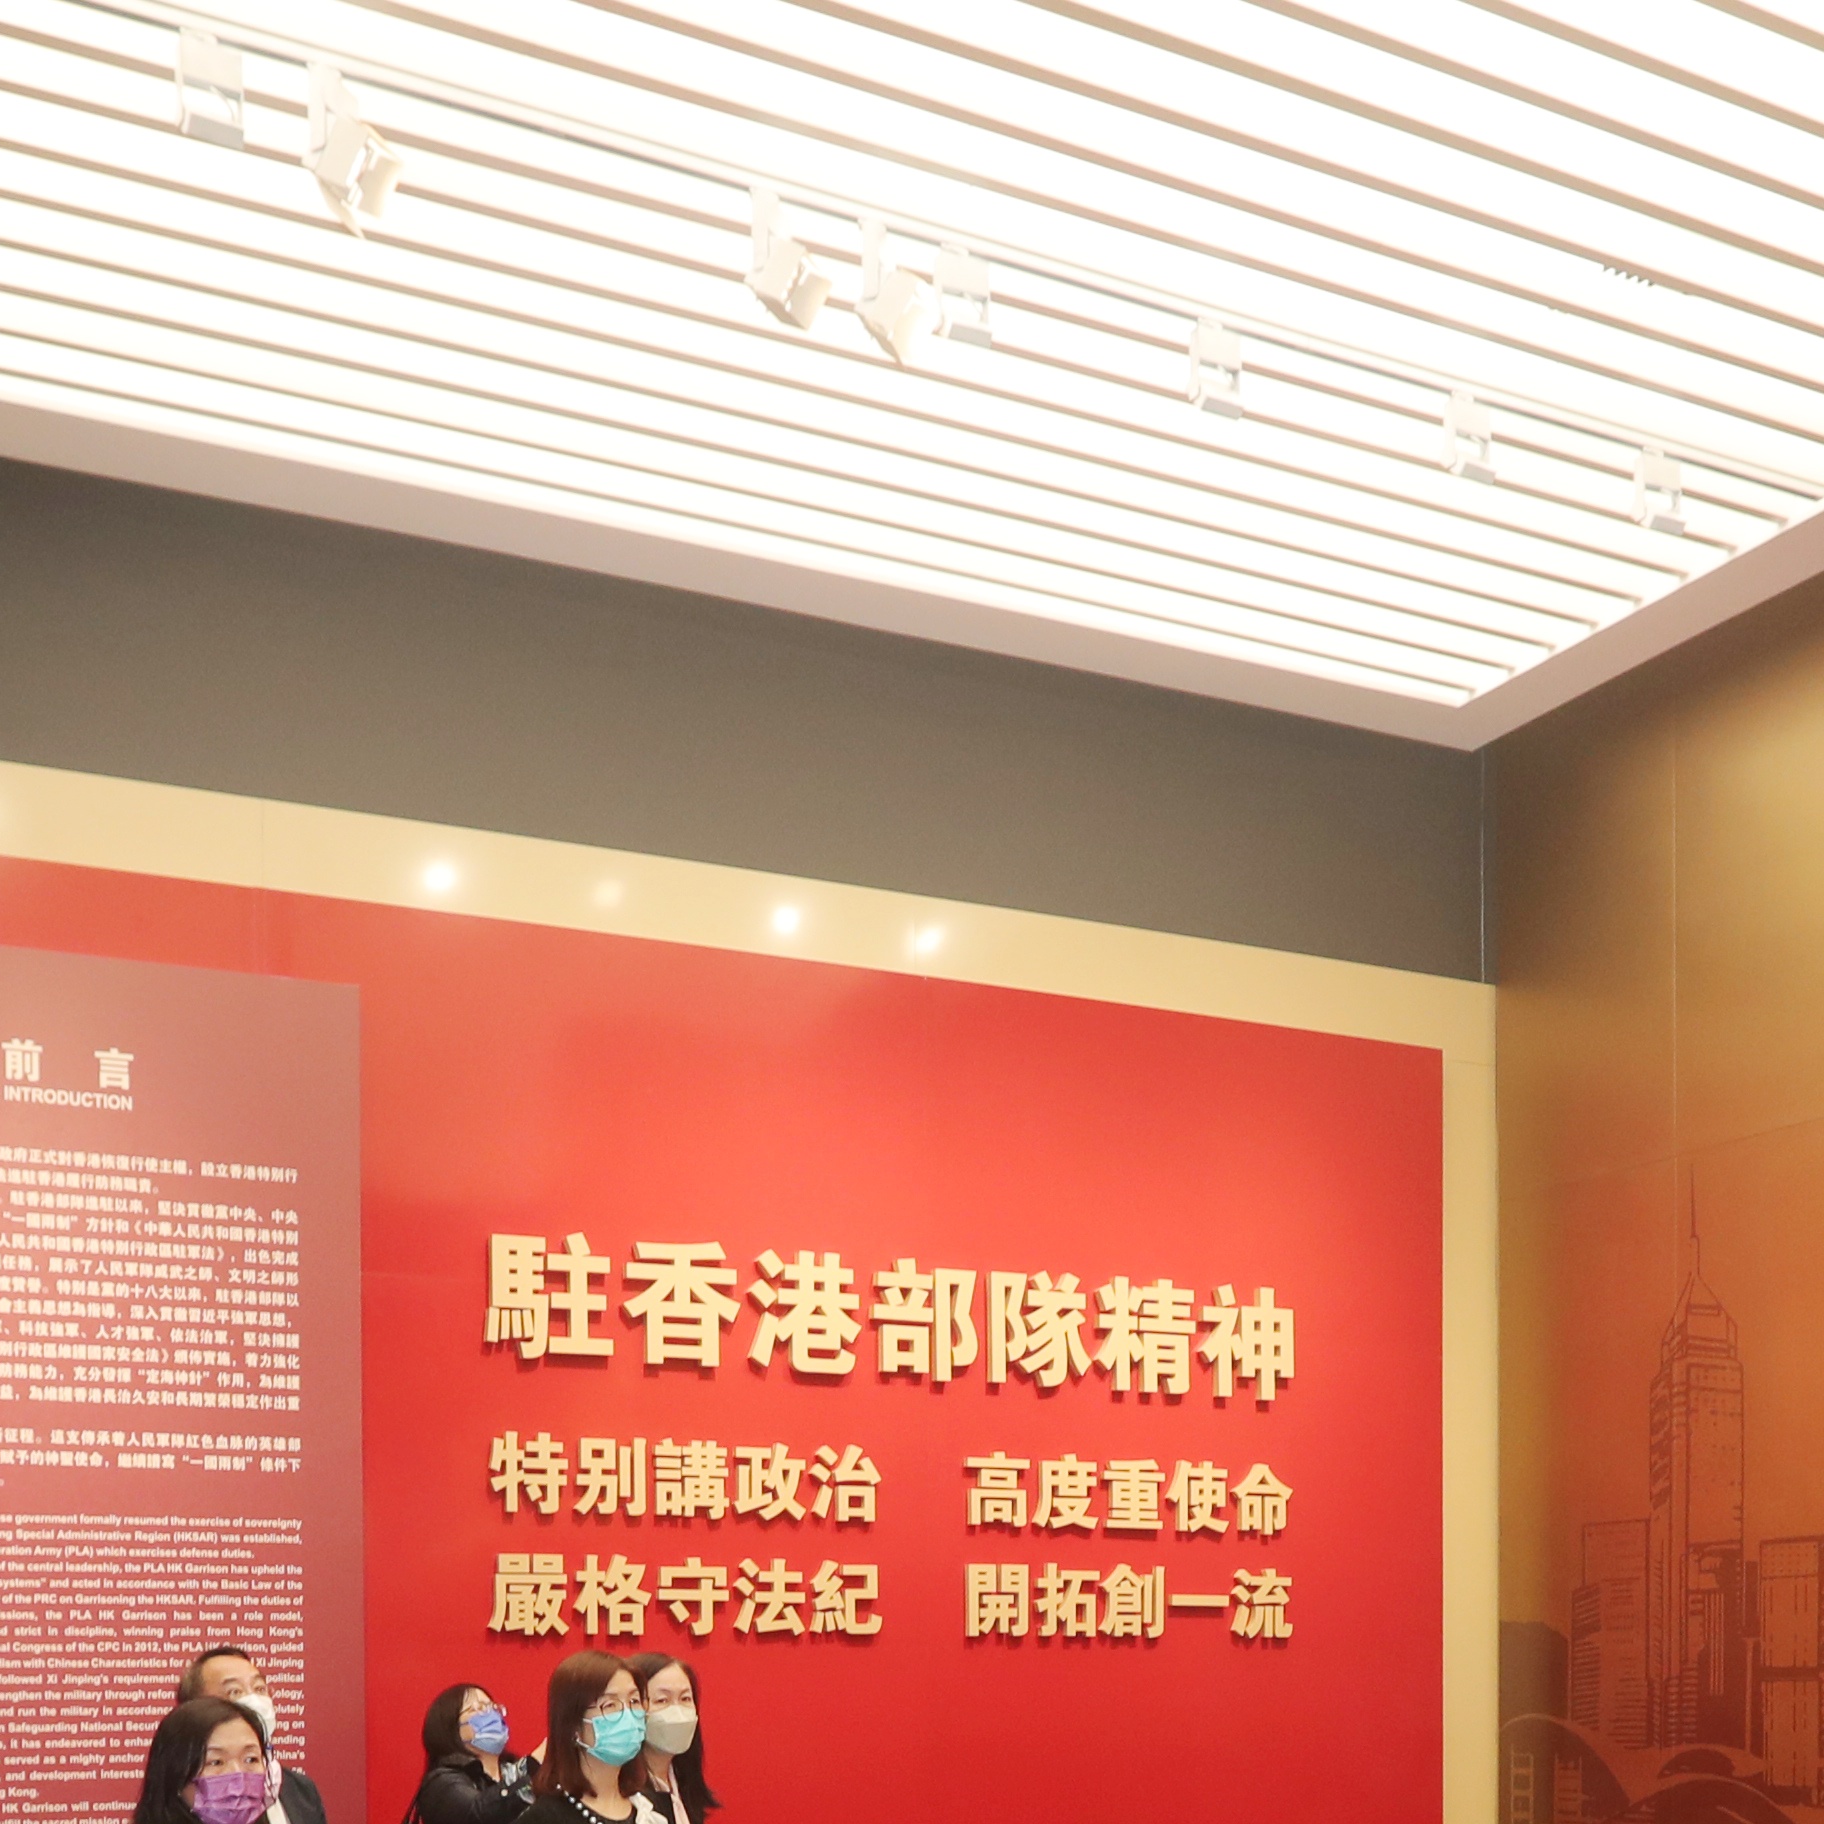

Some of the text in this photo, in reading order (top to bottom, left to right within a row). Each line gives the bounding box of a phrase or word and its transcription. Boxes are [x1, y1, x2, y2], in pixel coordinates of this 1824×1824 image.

[4, 1084, 133, 1111] INTRODUCTION
[484, 1231, 1297, 1402] 駐香港部隊精神
[964, 1451, 1293, 1536] 高度重使命
[14, 1514, 77, 1524] government
[79, 1513, 122, 1526] formally
[123, 1515, 168, 1525] resumed
[170, 1515, 186, 1526] the
[188, 1516, 230, 1526] exercise
[232, 1516, 243, 1527] of
[244, 1518, 302, 1530] sovereignty
[15, 1528, 54, 1540] Special
[56, 1529, 131, 1540] Administrative
[134, 1530, 170, 1543] Region
[220, 1534, 240, 1542] was
[243, 1533, 302, 1544] established,
[33, 1545, 62, 1557] Army
[64, 1545, 94, 1557] (PLA)
[95, 1546, 127, 1556] which
[128, 1547, 177, 1557] exercises
[179, 1547, 219, 1558] defense
[221, 1548, 254, 1558] duties.
[7, 1561, 25, 1571] the
[26, 1561, 63, 1571] central
[65, 1561, 122, 1573] leadership,
[124, 1562, 141, 1572] the
[143, 1562, 165, 1573] PLA
[166, 1562, 182, 1573] HK
[184, 1562, 228, 1573] Garrison
[230, 1563, 249, 1574] has
[250, 1564, 285, 1575] upheld
[286, 1564, 302, 1574] the
[49, 1577, 69, 1588] and
[71, 1578, 100, 1588] acted
[103, 1577, 113, 1588] in
[116, 1579, 175, 1588] accordance
[177, 1578, 199, 1589] with
[201, 1579, 218, 1589] the
[220, 1578, 249, 1589] Basic
[251, 1579, 272, 1589] Law
[274, 1579, 285, 1589] of
[286, 1580, 302, 1590] the
[1, 1593, 13, 1603] of
[14, 1593, 32, 1603] the
[33, 1593, 57, 1604] PRC
[59, 1595, 73, 1604] on
[74, 1593, 136, 1606] Garrisoning
[137, 1594, 154, 1604] the
[198, 1594, 241, 1606] Fulfilling
[242, 1595, 259, 1605] the
[260, 1595, 291, 1605] duties
[292, 1595, 303, 1605] of
[487, 1553, 1293, 1639] 嚴格守法紀 開拓創一流
[45, 1609, 62, 1619] the
[69, 1609, 92, 1620] PLA
[98, 1609, 114, 1620] HK
[121, 1609, 166, 1620] Garrison
[173, 1610, 192, 1620] has
[199, 1610, 224, 1620] been
[230, 1612, 237, 1620] a
[243, 1610, 263, 1620] role
[269, 1610, 303, 1621] model,
[14, 1626, 41, 1636] strict
[47, 1625, 58, 1635] in
[64, 1625, 117, 1637] discipline,
[122, 1625, 164, 1638] winning
[169, 1626, 201, 1637] praise
[206, 1625, 231, 1636] from
[236, 1625, 263, 1638] Hong
[12, 1641, 63, 1654] Congress
[65, 1641, 77, 1652] of
[77, 1641, 95, 1652] the
[96, 1641, 120, 1652] CPC
[122, 1641, 132, 1651] in
[134, 1641, 161, 1652] 2012,
[163, 1641, 180, 1652] the
[181, 1641, 203, 1652] PLA
